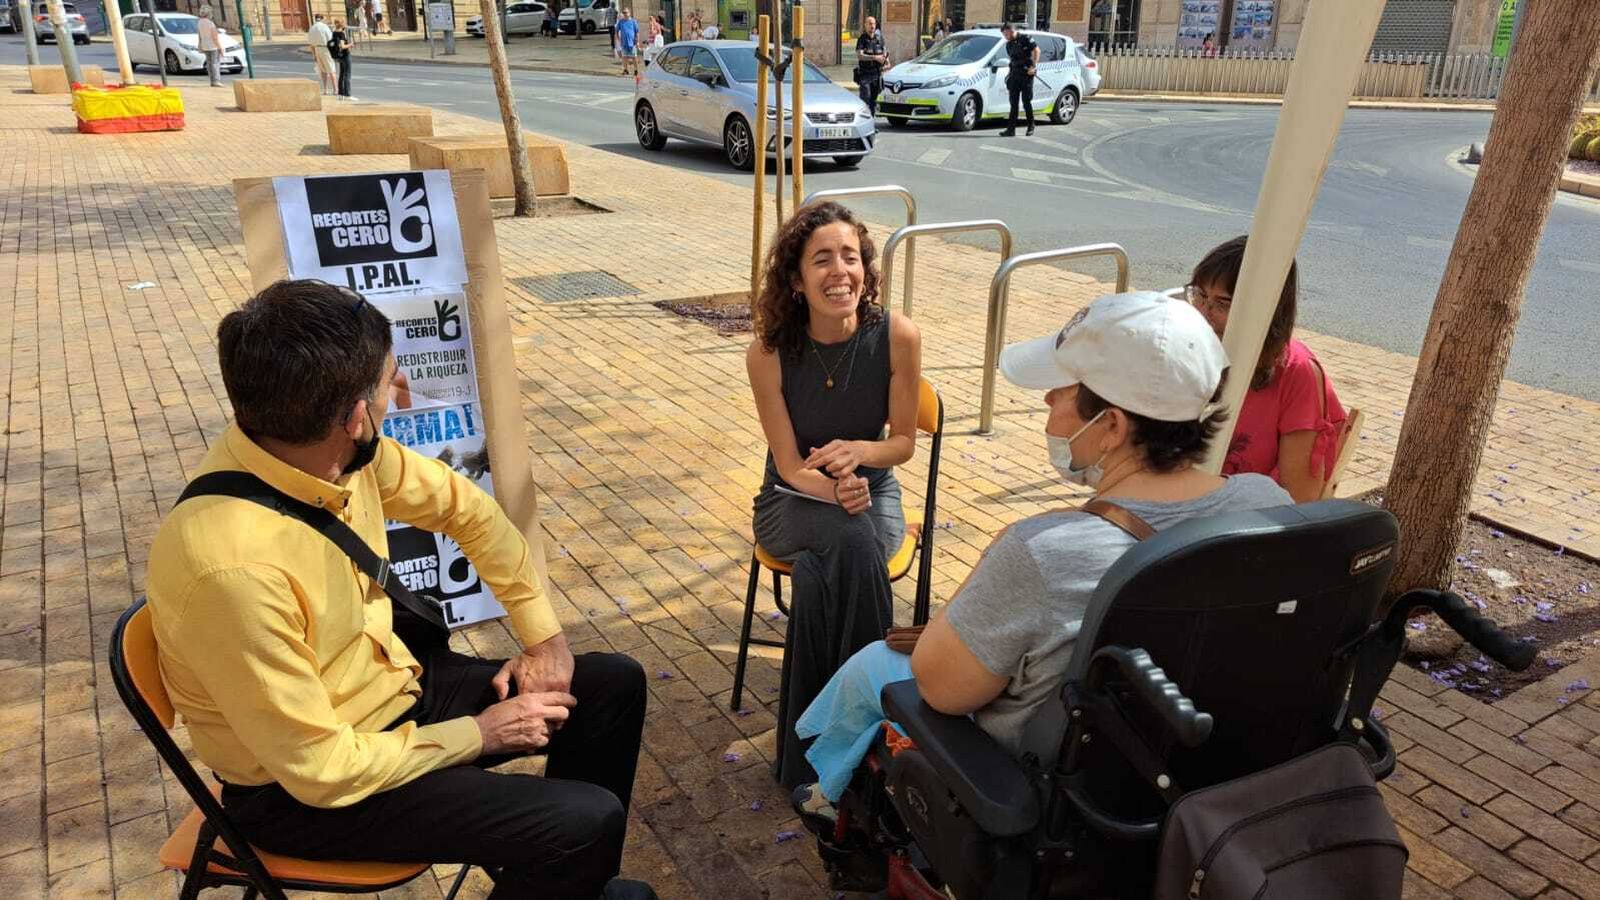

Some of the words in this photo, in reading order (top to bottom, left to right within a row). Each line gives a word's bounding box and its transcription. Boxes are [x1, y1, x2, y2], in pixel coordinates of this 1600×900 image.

[312, 210, 388, 228] RECORTES
[332, 225, 390, 248] CERO
[395, 317, 437, 328] RECORTES
[406, 326, 437, 339] CERO
[397, 349, 466, 367] REDISTRIBUIR
[410, 368, 423, 380] LA
[427, 363, 468, 379] RIQUEZA
